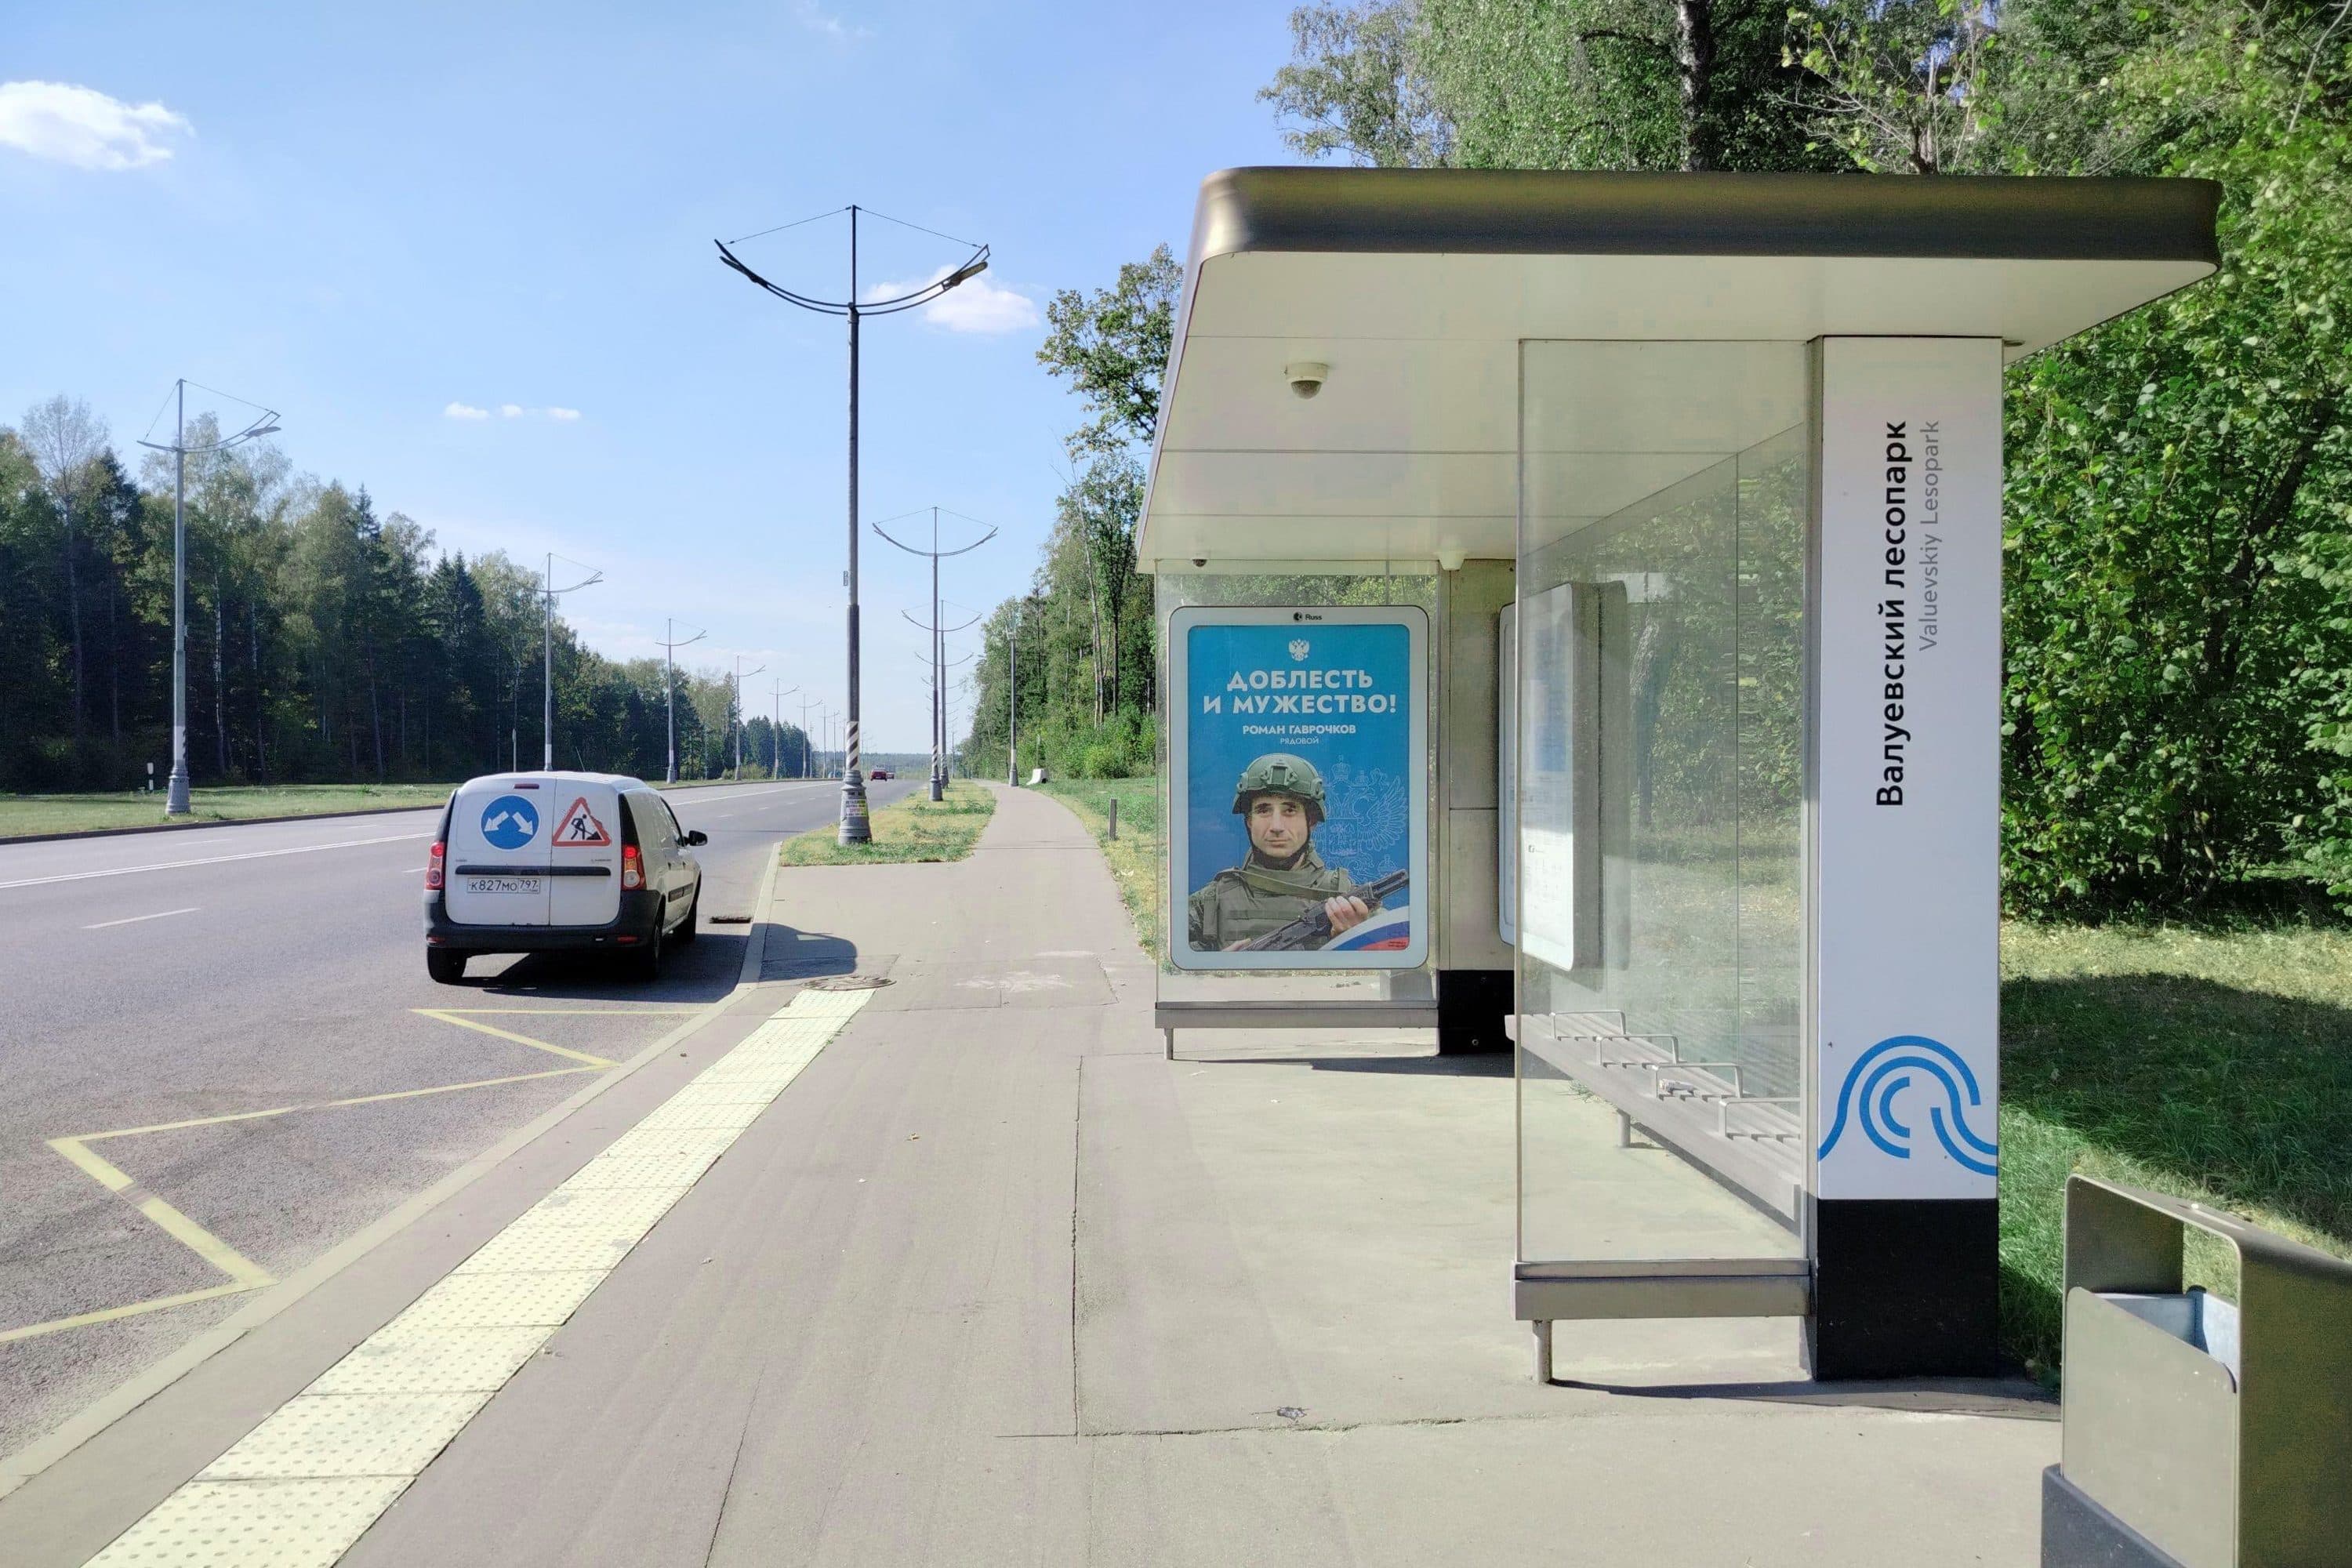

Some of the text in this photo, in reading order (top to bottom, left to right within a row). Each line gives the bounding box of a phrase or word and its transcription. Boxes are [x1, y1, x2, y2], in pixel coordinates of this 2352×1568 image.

[1918, 420, 1943, 652] Valuevskiy Lesopark
[1876, 420, 1912, 806] Валуевский лесопарк
[1226, 670, 1373, 691] ДОБЛЕСТЬ
[1203, 694, 1397, 714] И МУЖЕСТВО!
[1242, 724, 1356, 735] РОМАН ГАВРОЧКОВ
[1279, 735, 1319, 746] РЯДОВОЙ
